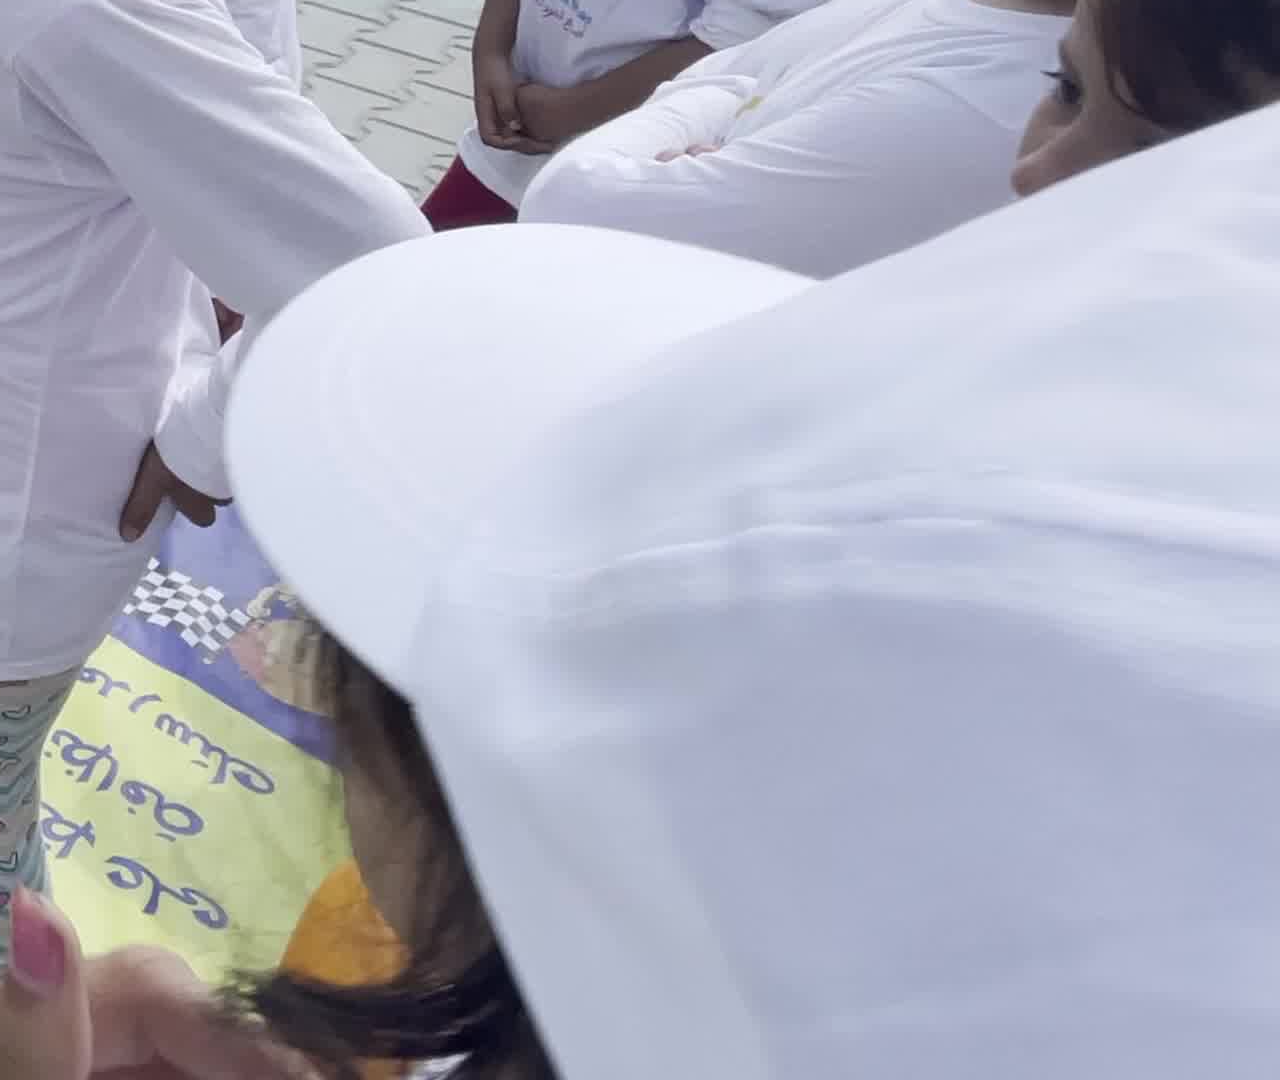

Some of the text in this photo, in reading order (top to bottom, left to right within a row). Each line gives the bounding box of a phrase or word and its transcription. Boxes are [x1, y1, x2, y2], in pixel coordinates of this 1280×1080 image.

[44, 729, 205, 842] نظافة
[79, 667, 275, 795] مدرستك
[104, 855, 229, 930] على
